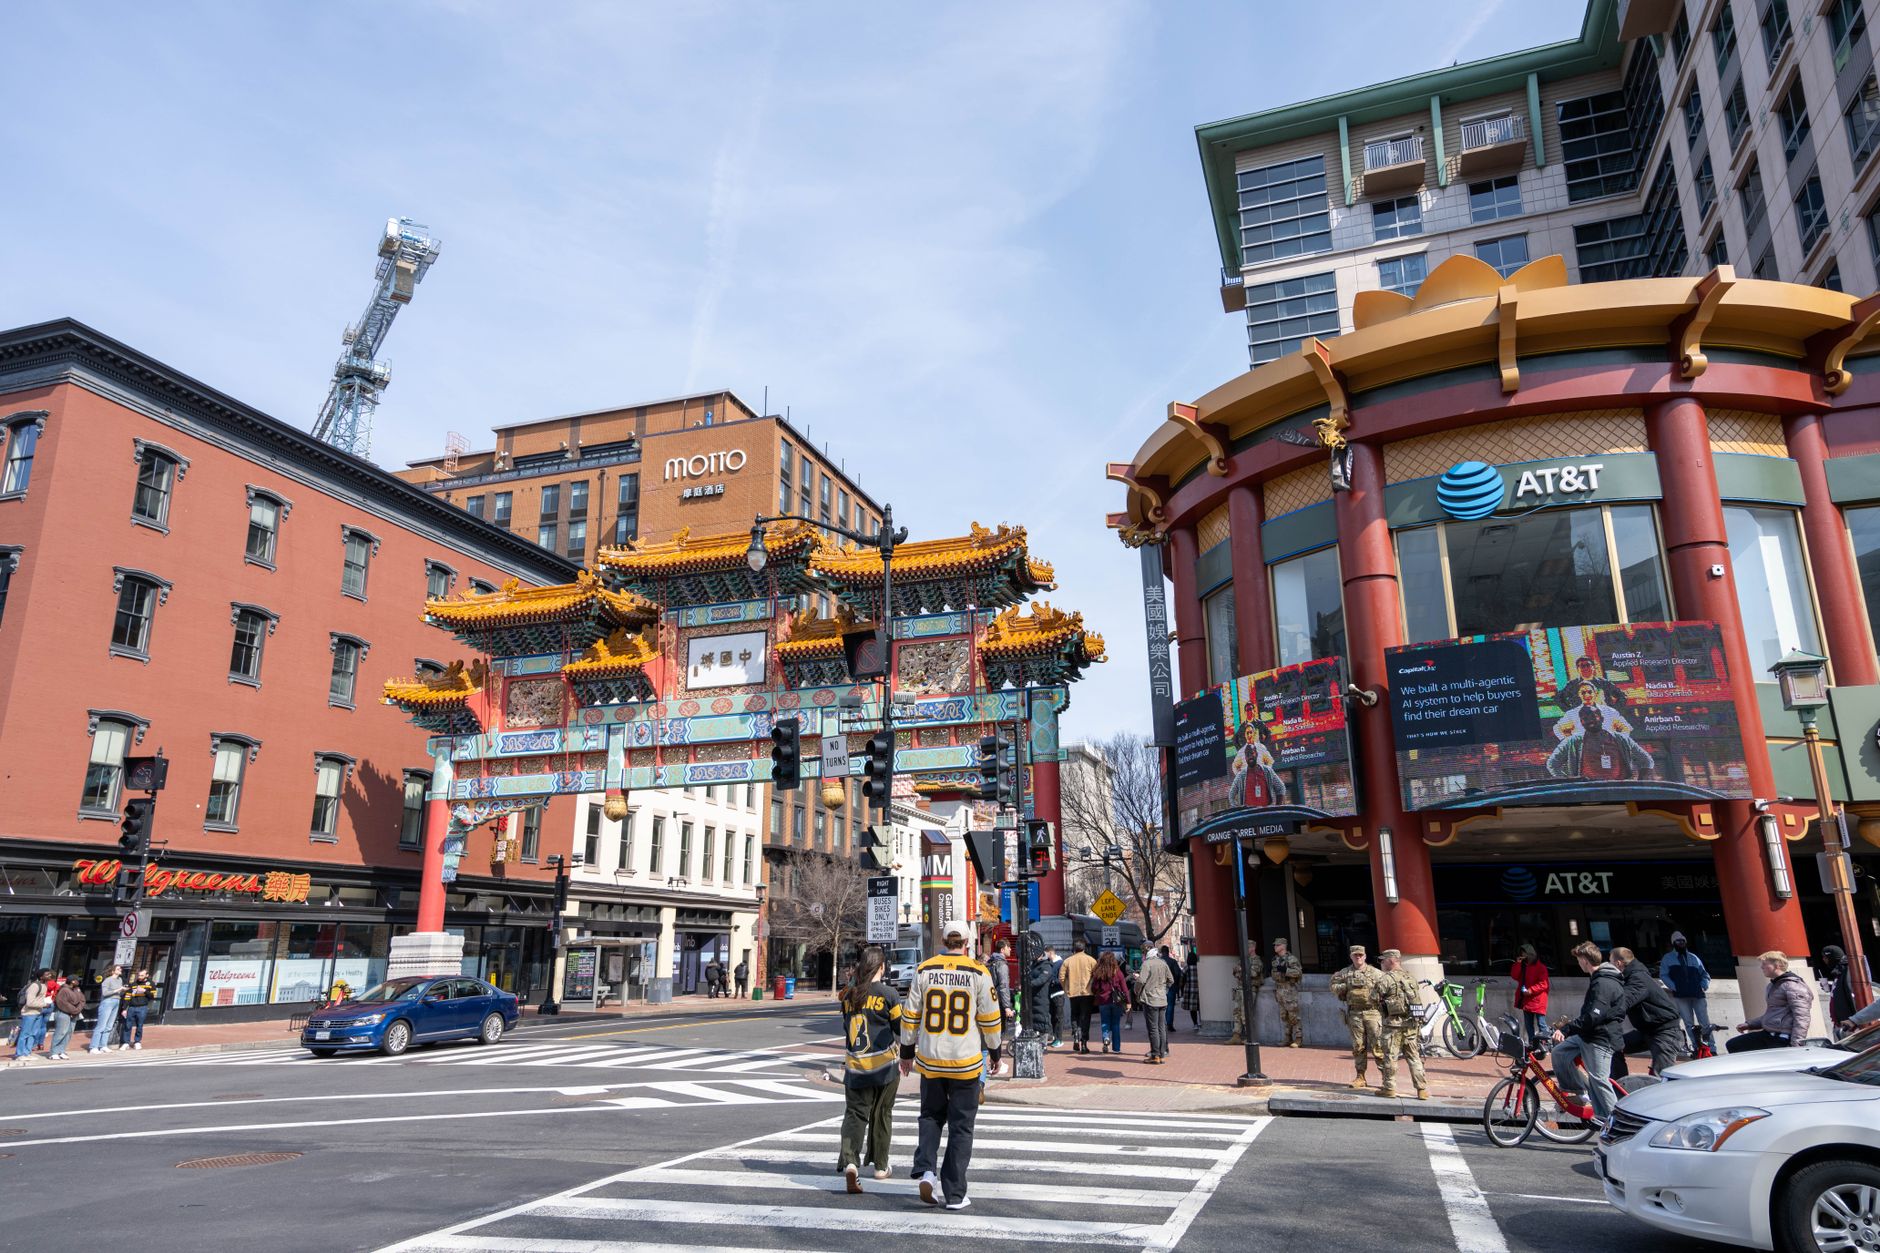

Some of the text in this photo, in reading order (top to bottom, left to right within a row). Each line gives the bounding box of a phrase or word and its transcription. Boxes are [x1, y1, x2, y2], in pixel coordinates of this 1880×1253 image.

[1516, 463, 1604, 498] AT&T
[1145, 584, 1171, 699] 美國娛樂公司
[1612, 660, 1638, 668] Applied
[1400, 675, 1516, 696] We built a multi-agentic
[1402, 689, 1522, 709] AI system to help buyers
[1403, 705, 1499, 721] find their dream car
[1645, 724, 1671, 732] Applied
[830, 740, 839, 751] NO
[826, 756, 846, 767] TURNS
[1207, 830, 1231, 842] ORANGE
[1259, 824, 1284, 835] MEDIA
[932, 854, 952, 876] M
[73, 859, 263, 897] Wlgreens
[263, 871, 311, 902] 藥房
[1544, 872, 1614, 895] AT&T
[873, 897, 891, 905] BUSES
[874, 905, 891, 913] BIKES
[874, 913, 890, 921] ONLY
[1104, 937, 1118, 946] 25
[208, 969, 257, 983] Walgreens
[928, 971, 971, 987] PASTRNAK
[925, 987, 971, 1036] 88
